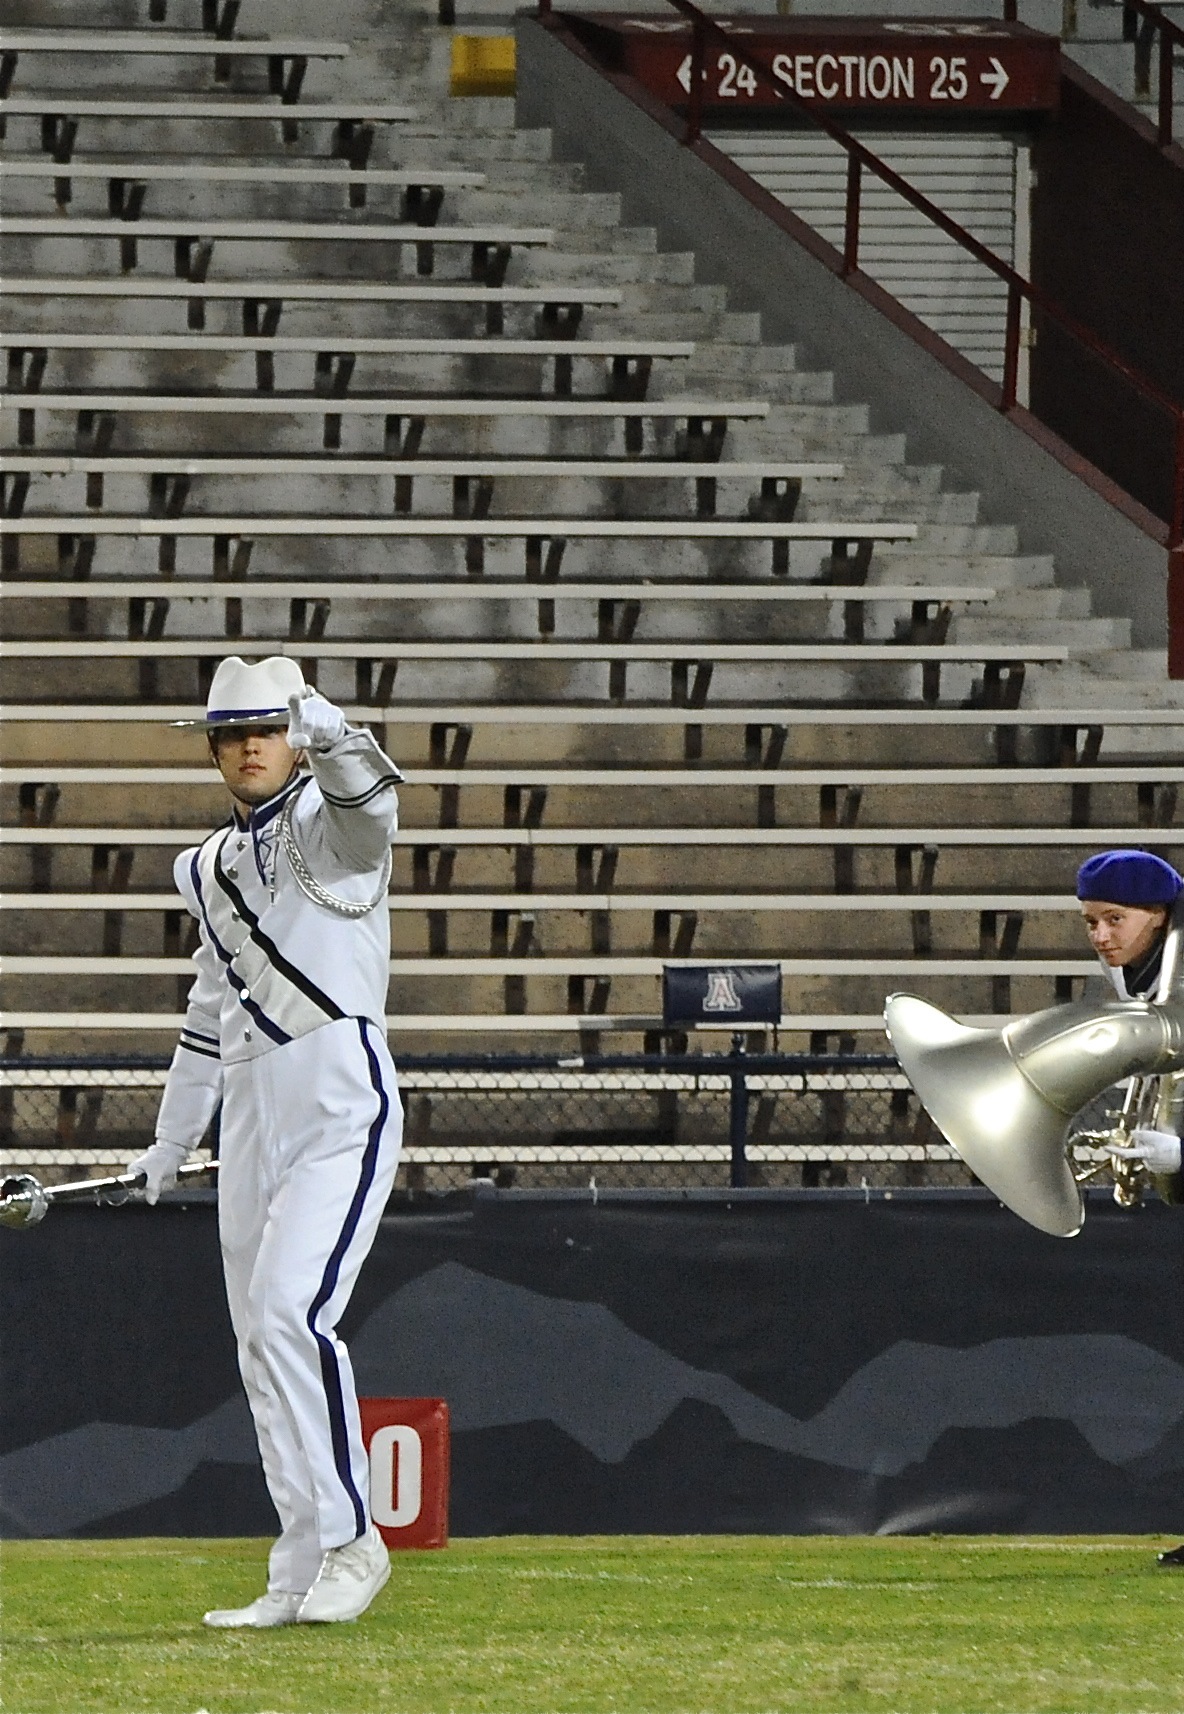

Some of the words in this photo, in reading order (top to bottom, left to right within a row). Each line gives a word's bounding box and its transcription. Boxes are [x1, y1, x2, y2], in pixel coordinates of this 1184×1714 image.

[716, 54, 758, 97] 24
[772, 55, 915, 99] SECTION
[929, 56, 968, 99] 25
[703, 973, 742, 1011] A
